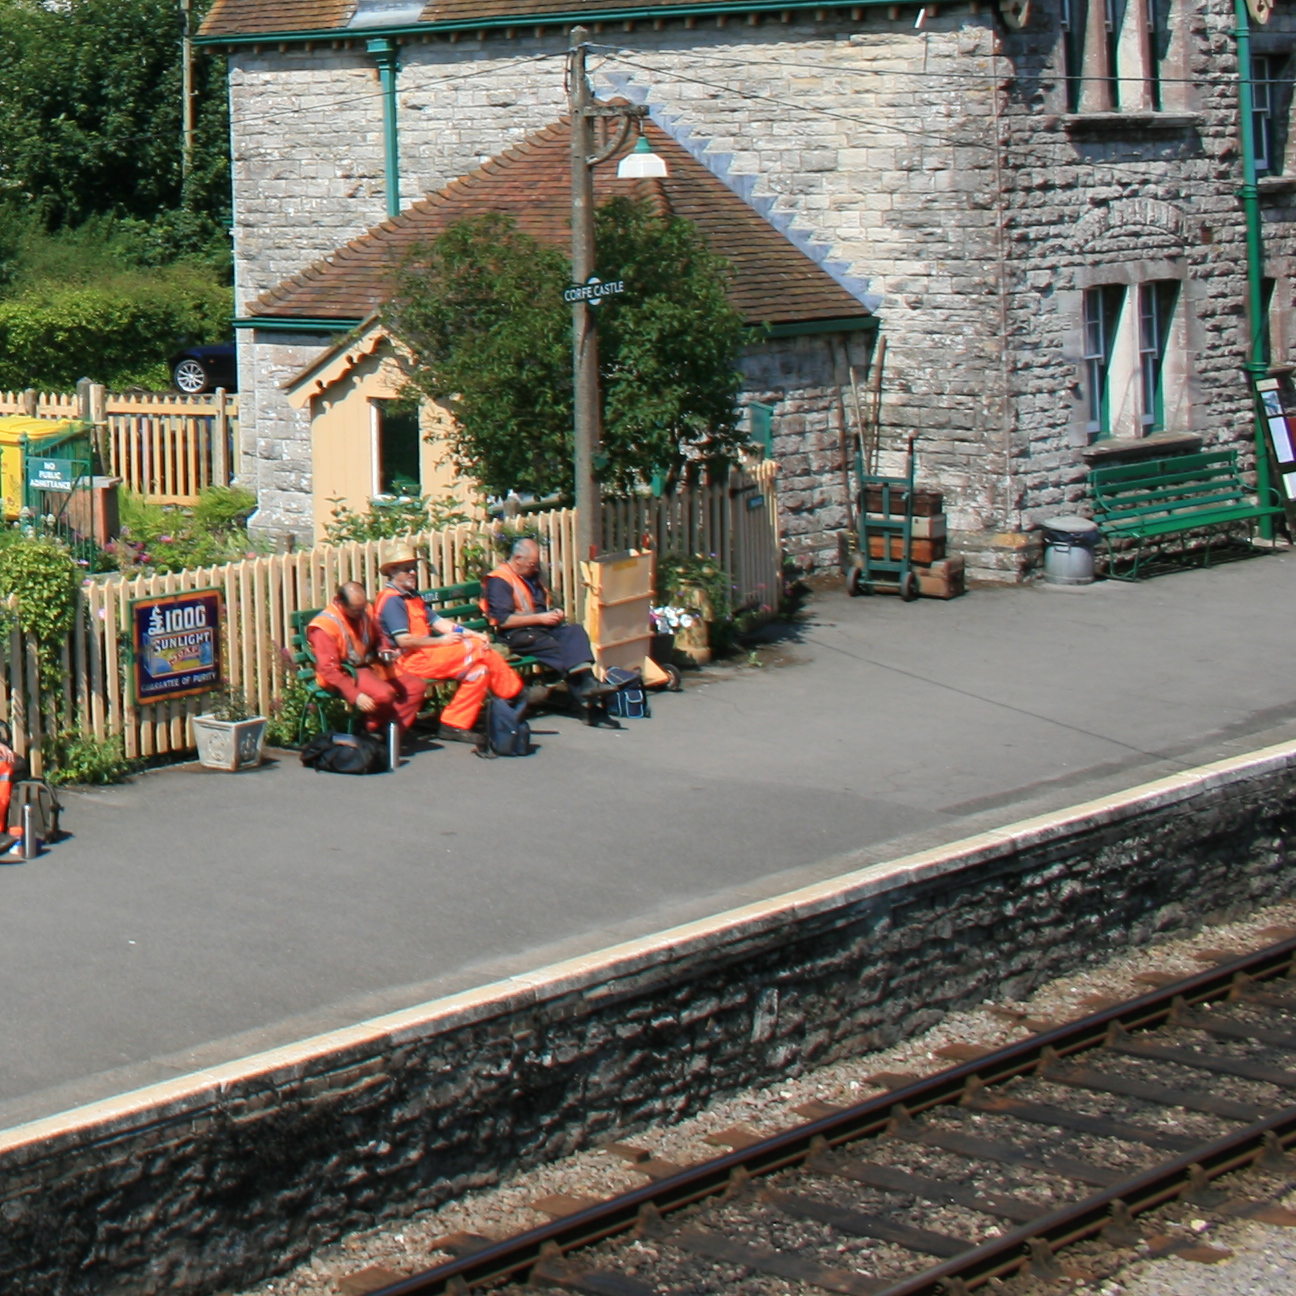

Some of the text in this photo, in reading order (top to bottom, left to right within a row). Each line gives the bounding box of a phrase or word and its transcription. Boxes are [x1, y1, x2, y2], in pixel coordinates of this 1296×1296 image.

[564, 280, 624, 302] CORFE CASTLE
[43, 461, 56, 470] NO
[38, 470, 62, 480] PUBLIC
[29, 478, 72, 490] ADMITTANCE
[153, 631, 210, 656] SUNLIGHT
[141, 671, 216, 692] GUARANTEE OF PURITY
